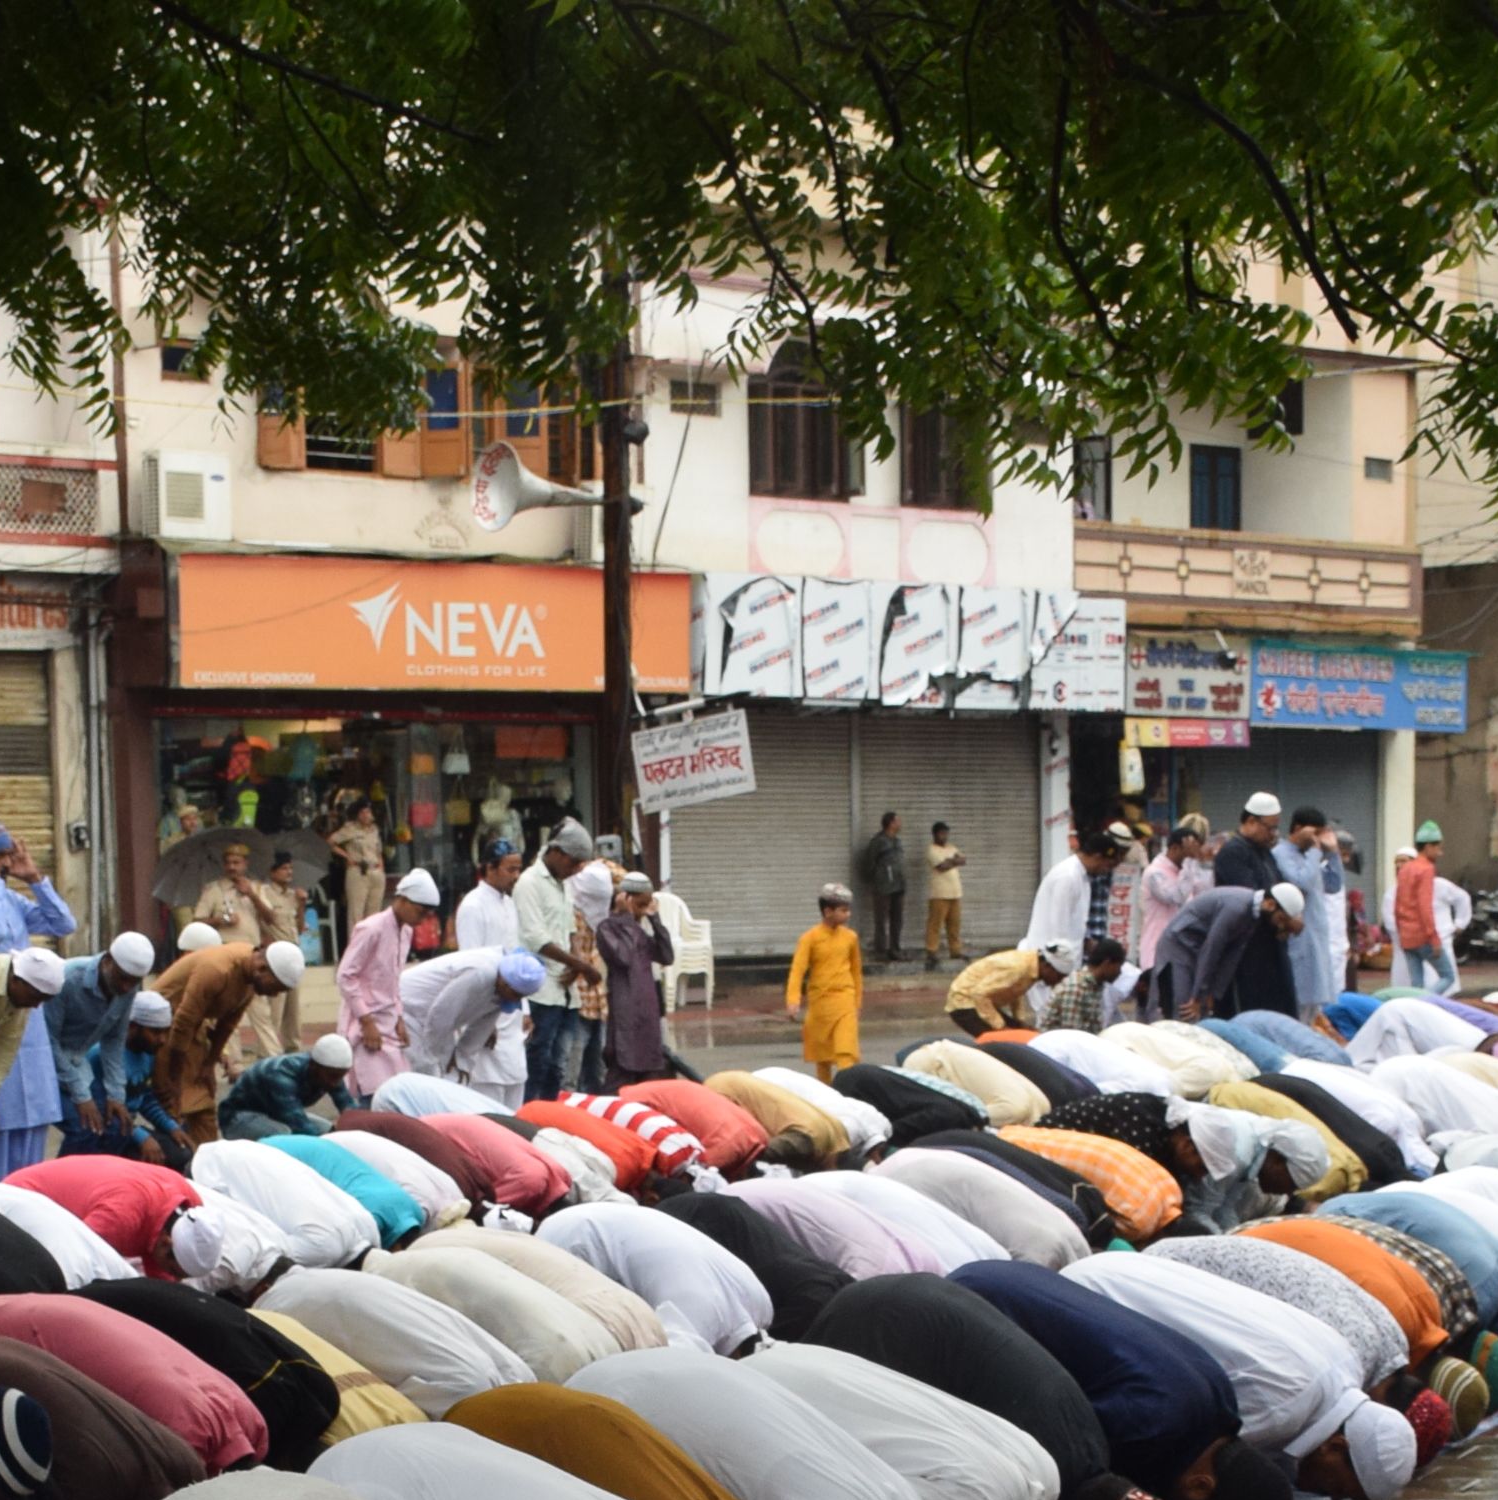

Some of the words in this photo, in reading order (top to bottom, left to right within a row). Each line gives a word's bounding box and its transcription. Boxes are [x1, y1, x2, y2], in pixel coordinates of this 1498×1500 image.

[405, 601, 546, 658] NEVA
[405, 664, 480, 677] CLOTHING
[484, 664, 514, 677] FOR
[516, 665, 547, 677] LIFE
[193, 671, 246, 684] EXCLUSIVE
[248, 672, 316, 684] SHOWROOM
